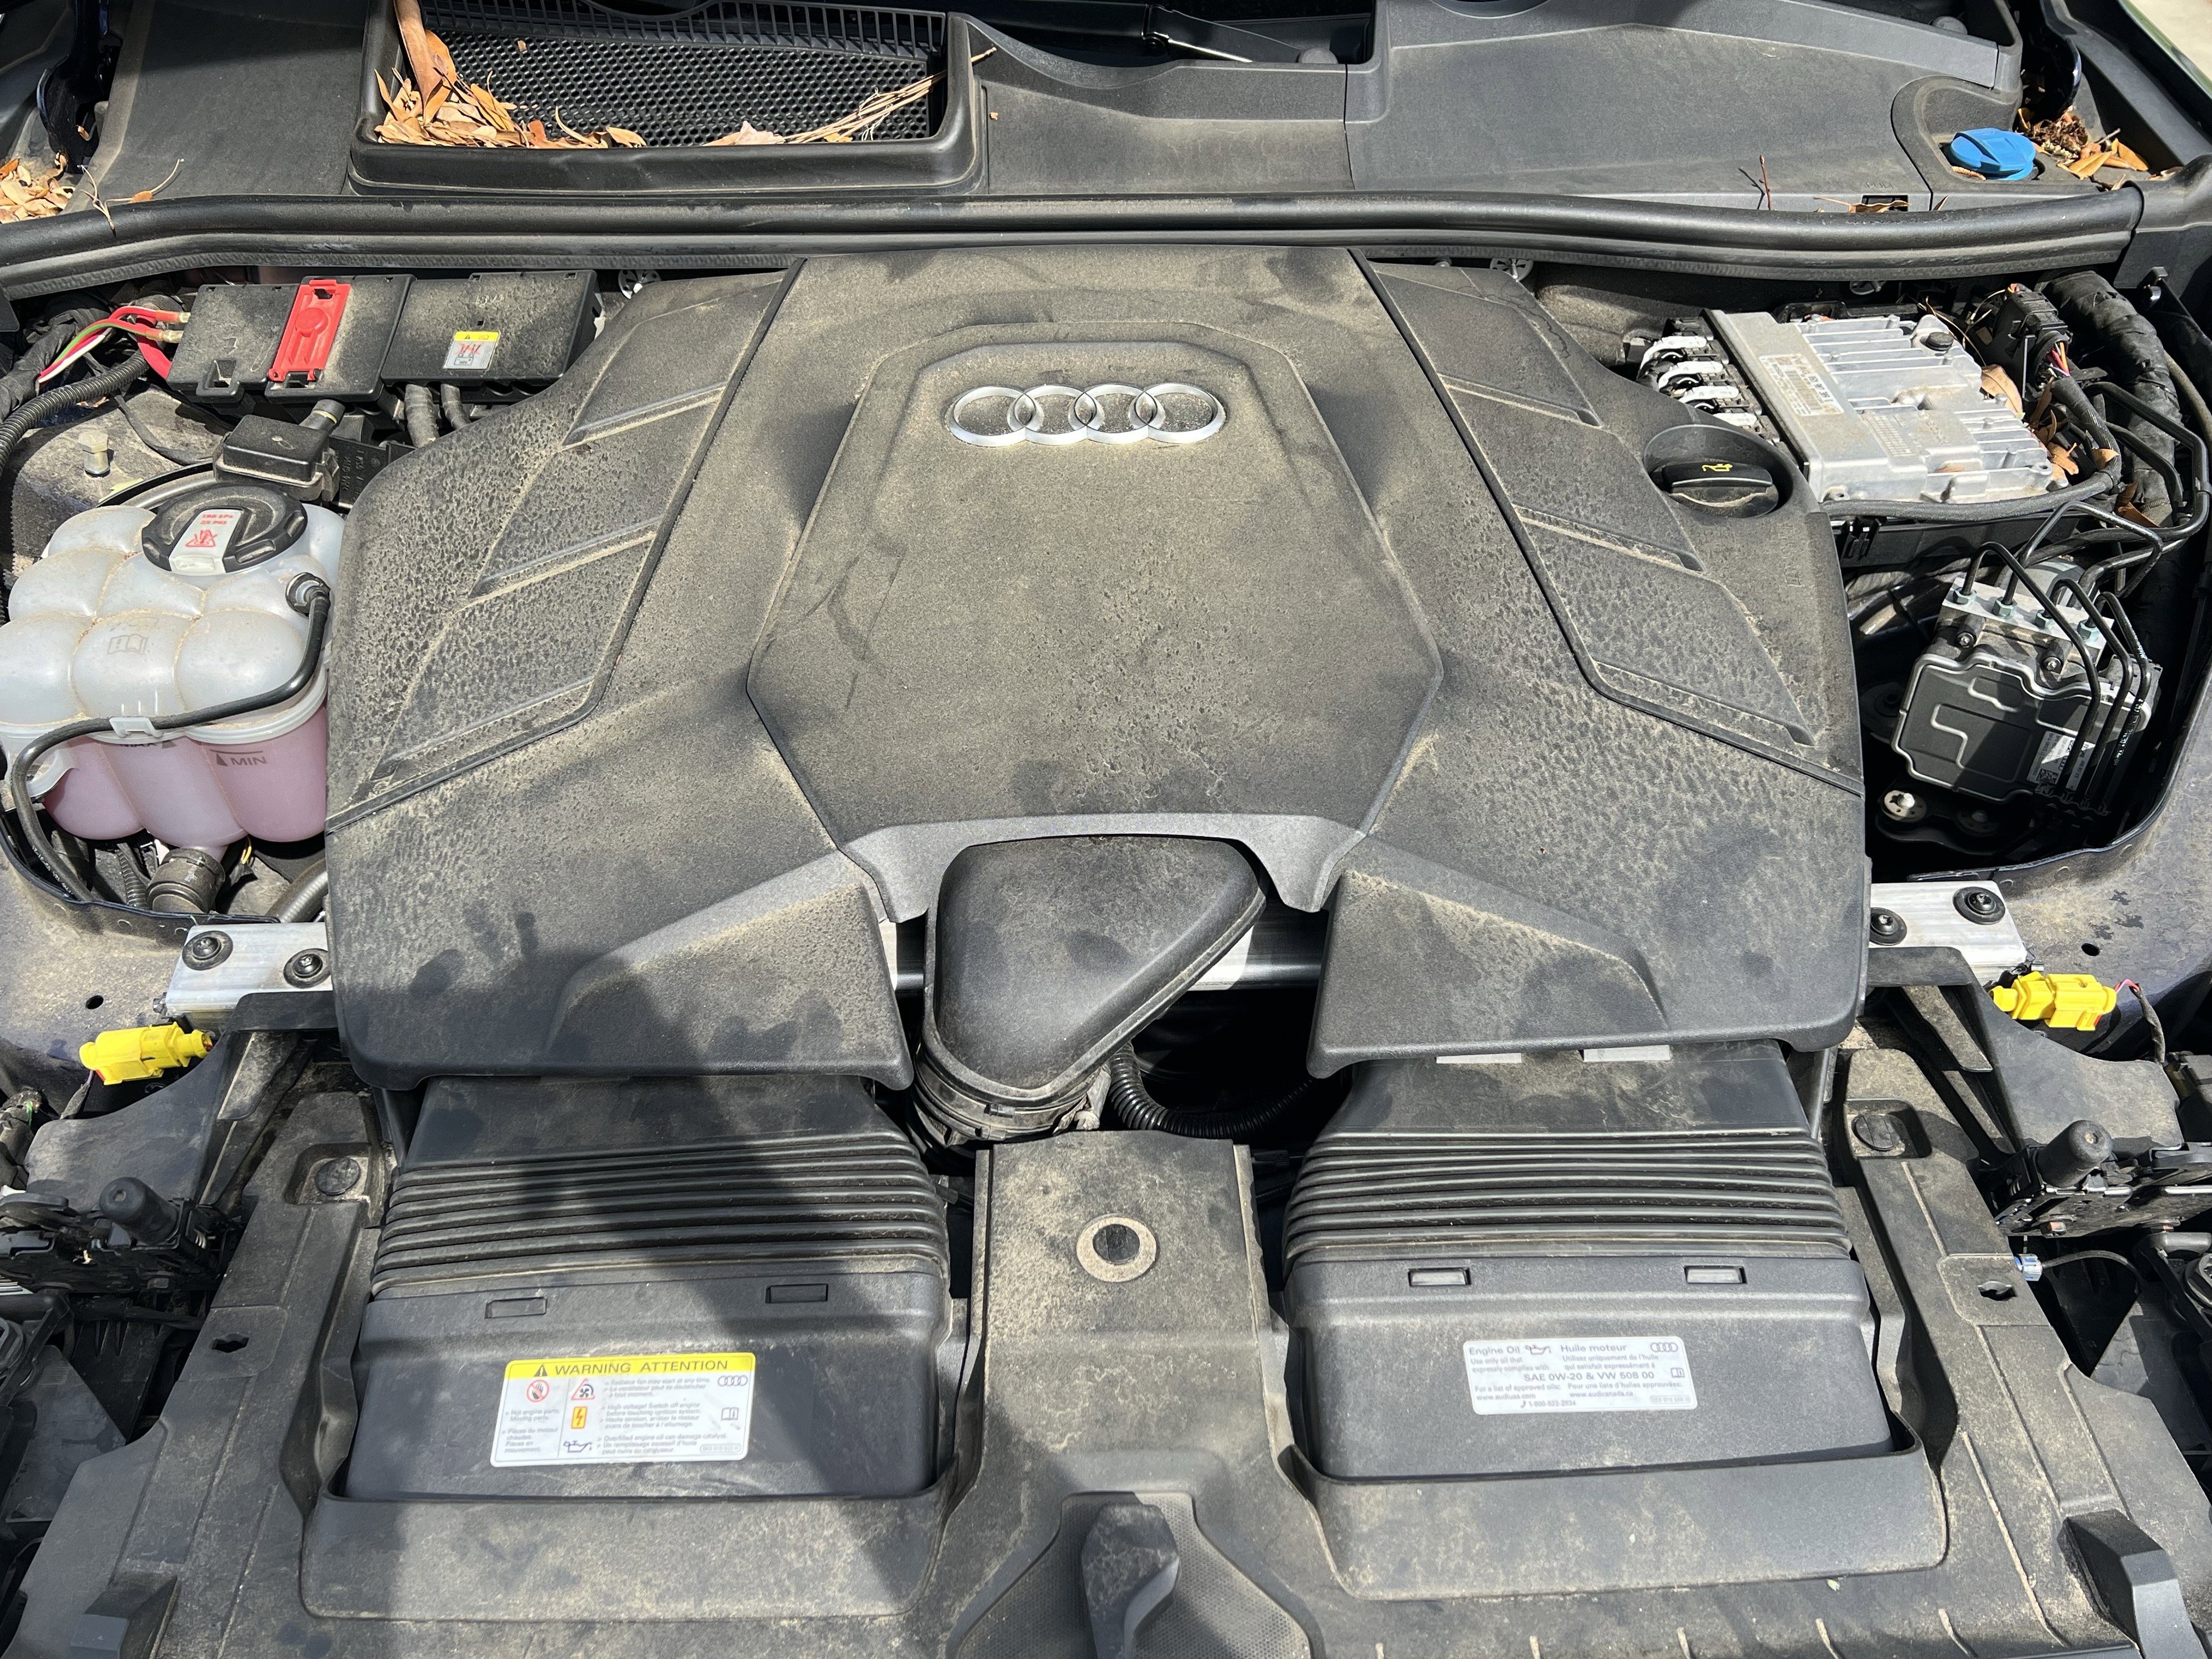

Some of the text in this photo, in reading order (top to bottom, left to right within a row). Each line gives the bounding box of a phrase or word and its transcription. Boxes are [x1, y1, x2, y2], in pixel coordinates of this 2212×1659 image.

[230, 757, 267, 765] MIN
[555, 1361, 728, 1375] WARNING ATTENTION
[1524, 1373, 1546, 1381] SAE
[1549, 1372, 1583, 1381] 0W-20
